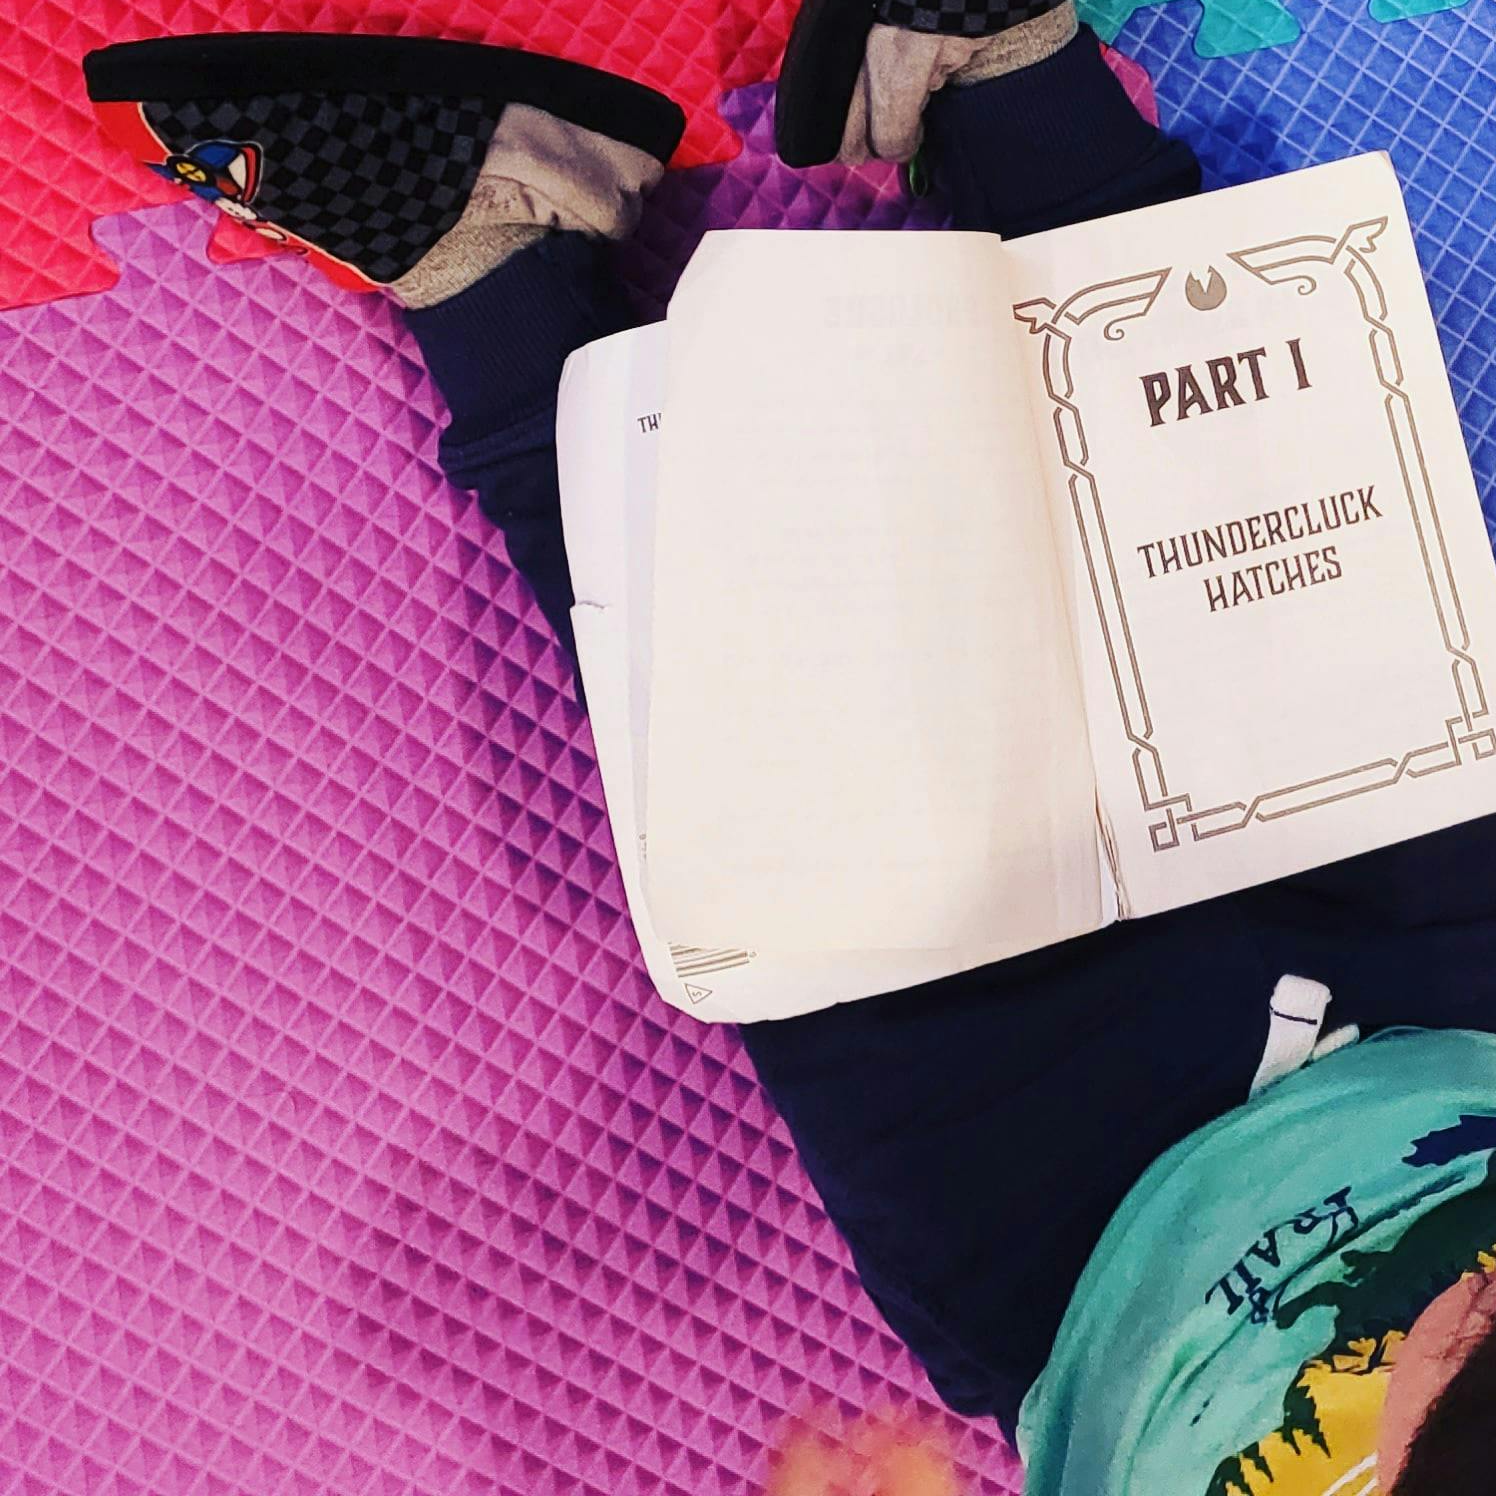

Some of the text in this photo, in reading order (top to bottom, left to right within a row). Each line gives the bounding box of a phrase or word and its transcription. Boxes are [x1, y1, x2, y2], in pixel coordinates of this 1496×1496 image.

[1138, 338, 1312, 427] PART I
[1137, 485, 1384, 578] THUNDERCLUCK
[1204, 545, 1343, 612] HATCHES
